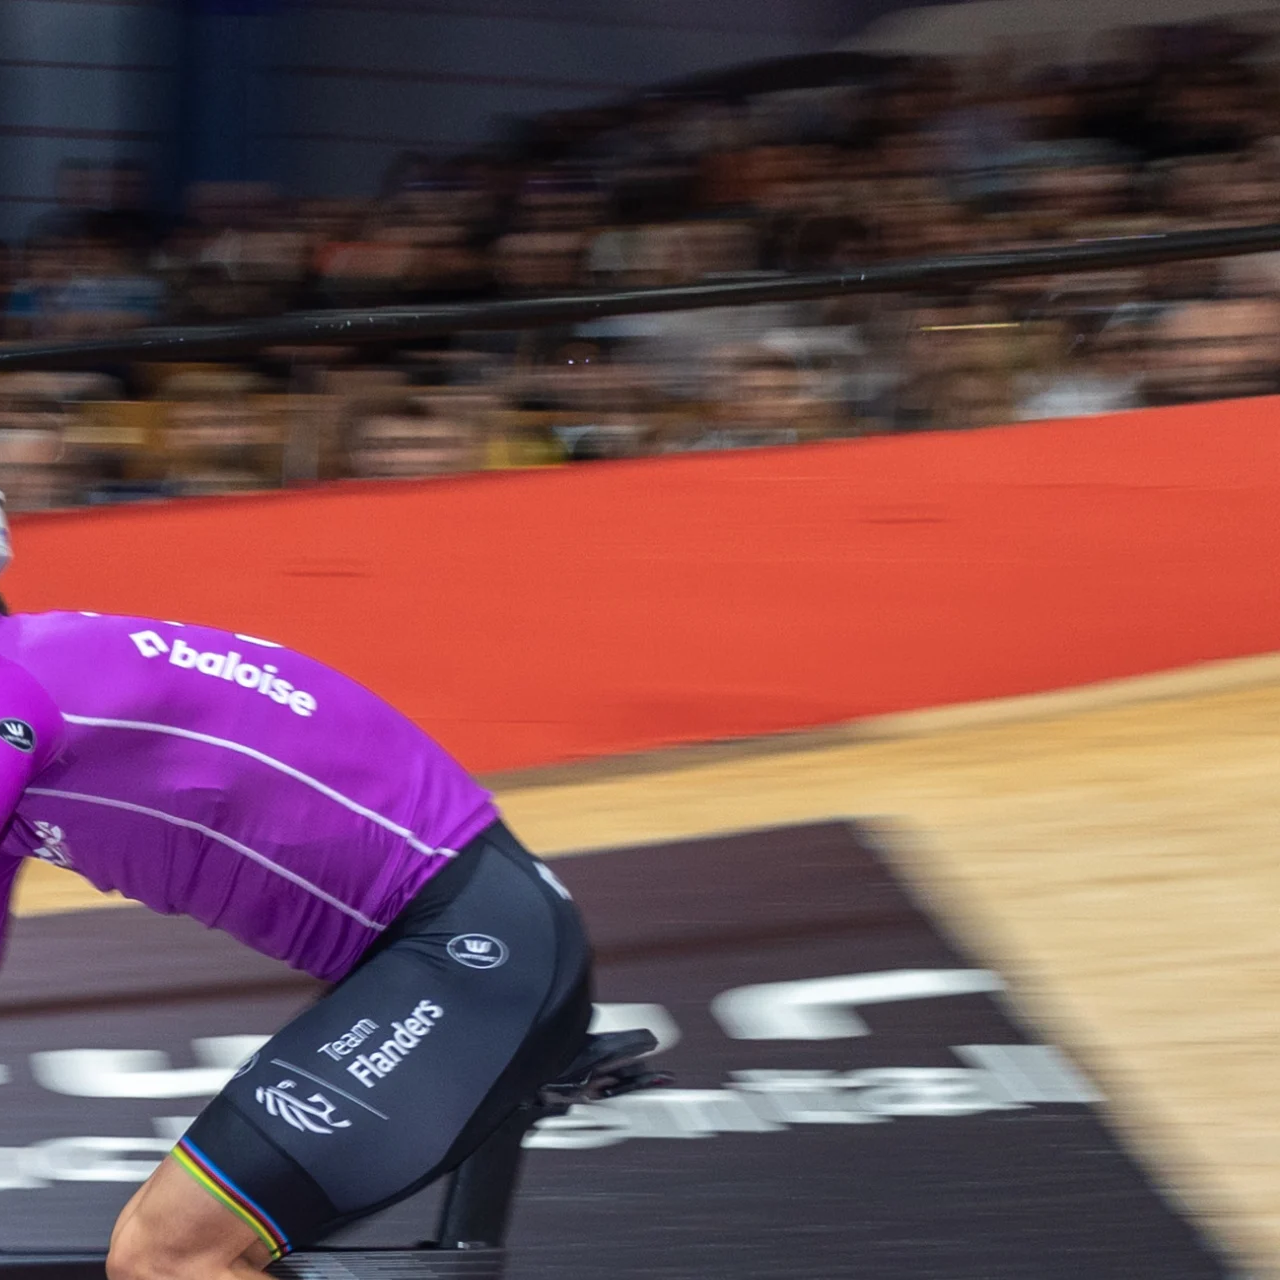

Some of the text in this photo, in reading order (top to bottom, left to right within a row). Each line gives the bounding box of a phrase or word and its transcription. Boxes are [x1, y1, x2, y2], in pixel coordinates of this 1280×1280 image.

[169, 639, 318, 717] baloise
[317, 1018, 379, 1061] Team
[346, 1000, 444, 1088] Flanders
